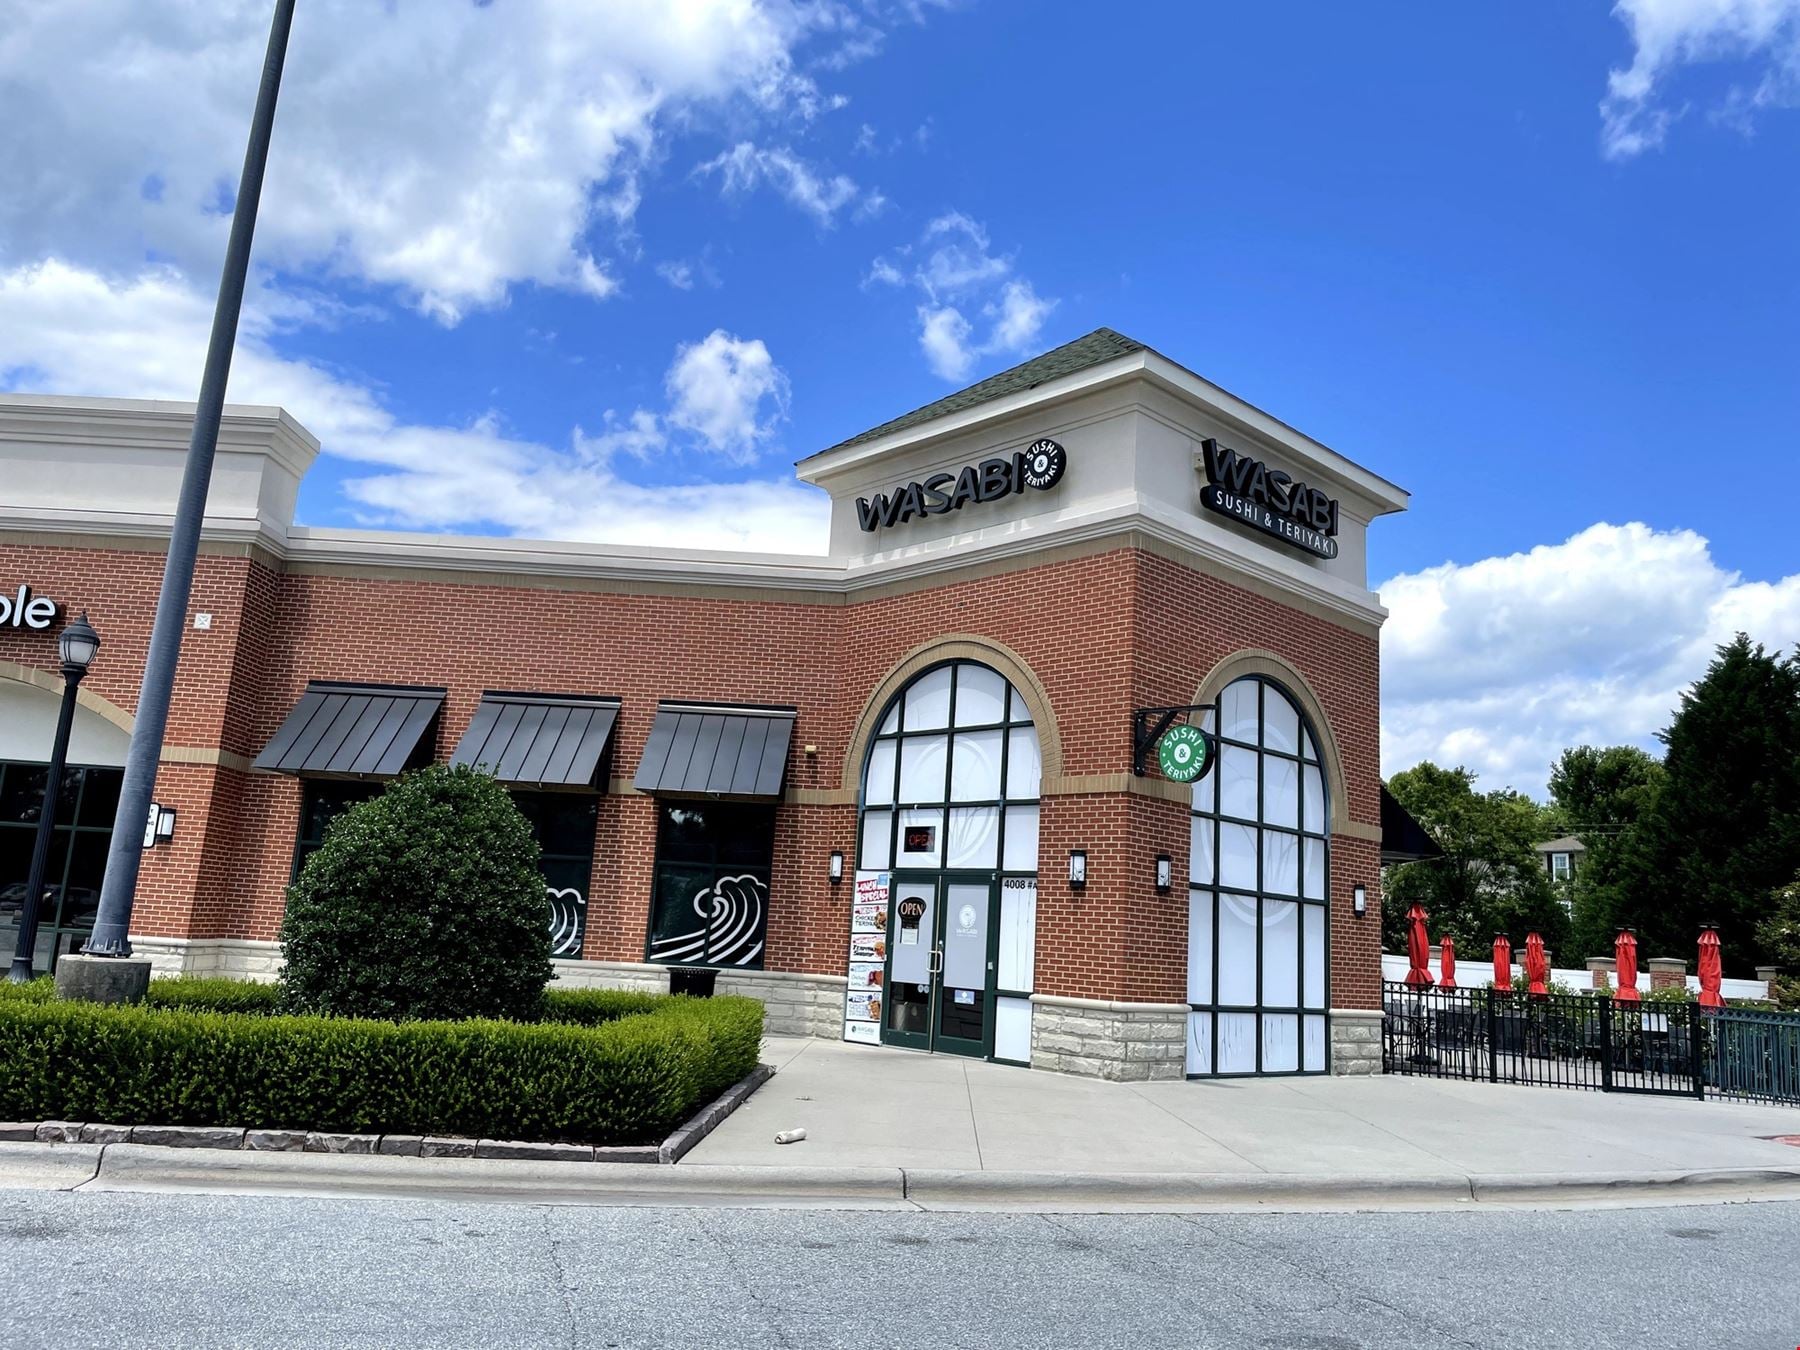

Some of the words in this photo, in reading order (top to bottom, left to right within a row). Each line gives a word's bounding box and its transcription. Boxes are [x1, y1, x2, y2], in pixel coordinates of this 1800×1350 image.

[1026, 440, 1058, 461] SUSHI
[1024, 464, 1058, 487] TERIYAKI
[856, 452, 1024, 532] WASABI
[1201, 438, 1339, 537] WASABI
[1216, 490, 1258, 521] SUSHI
[1264, 512, 1272, 528] &
[1278, 518, 1334, 555] TERIYAKI
[1164, 727, 1201, 749] SUSHI
[1163, 756, 1203, 779] TERIYAKI
[908, 834, 934, 847] OPEN
[1004, 879, 1026, 889] 4008
[900, 902, 924, 916] OPEN
